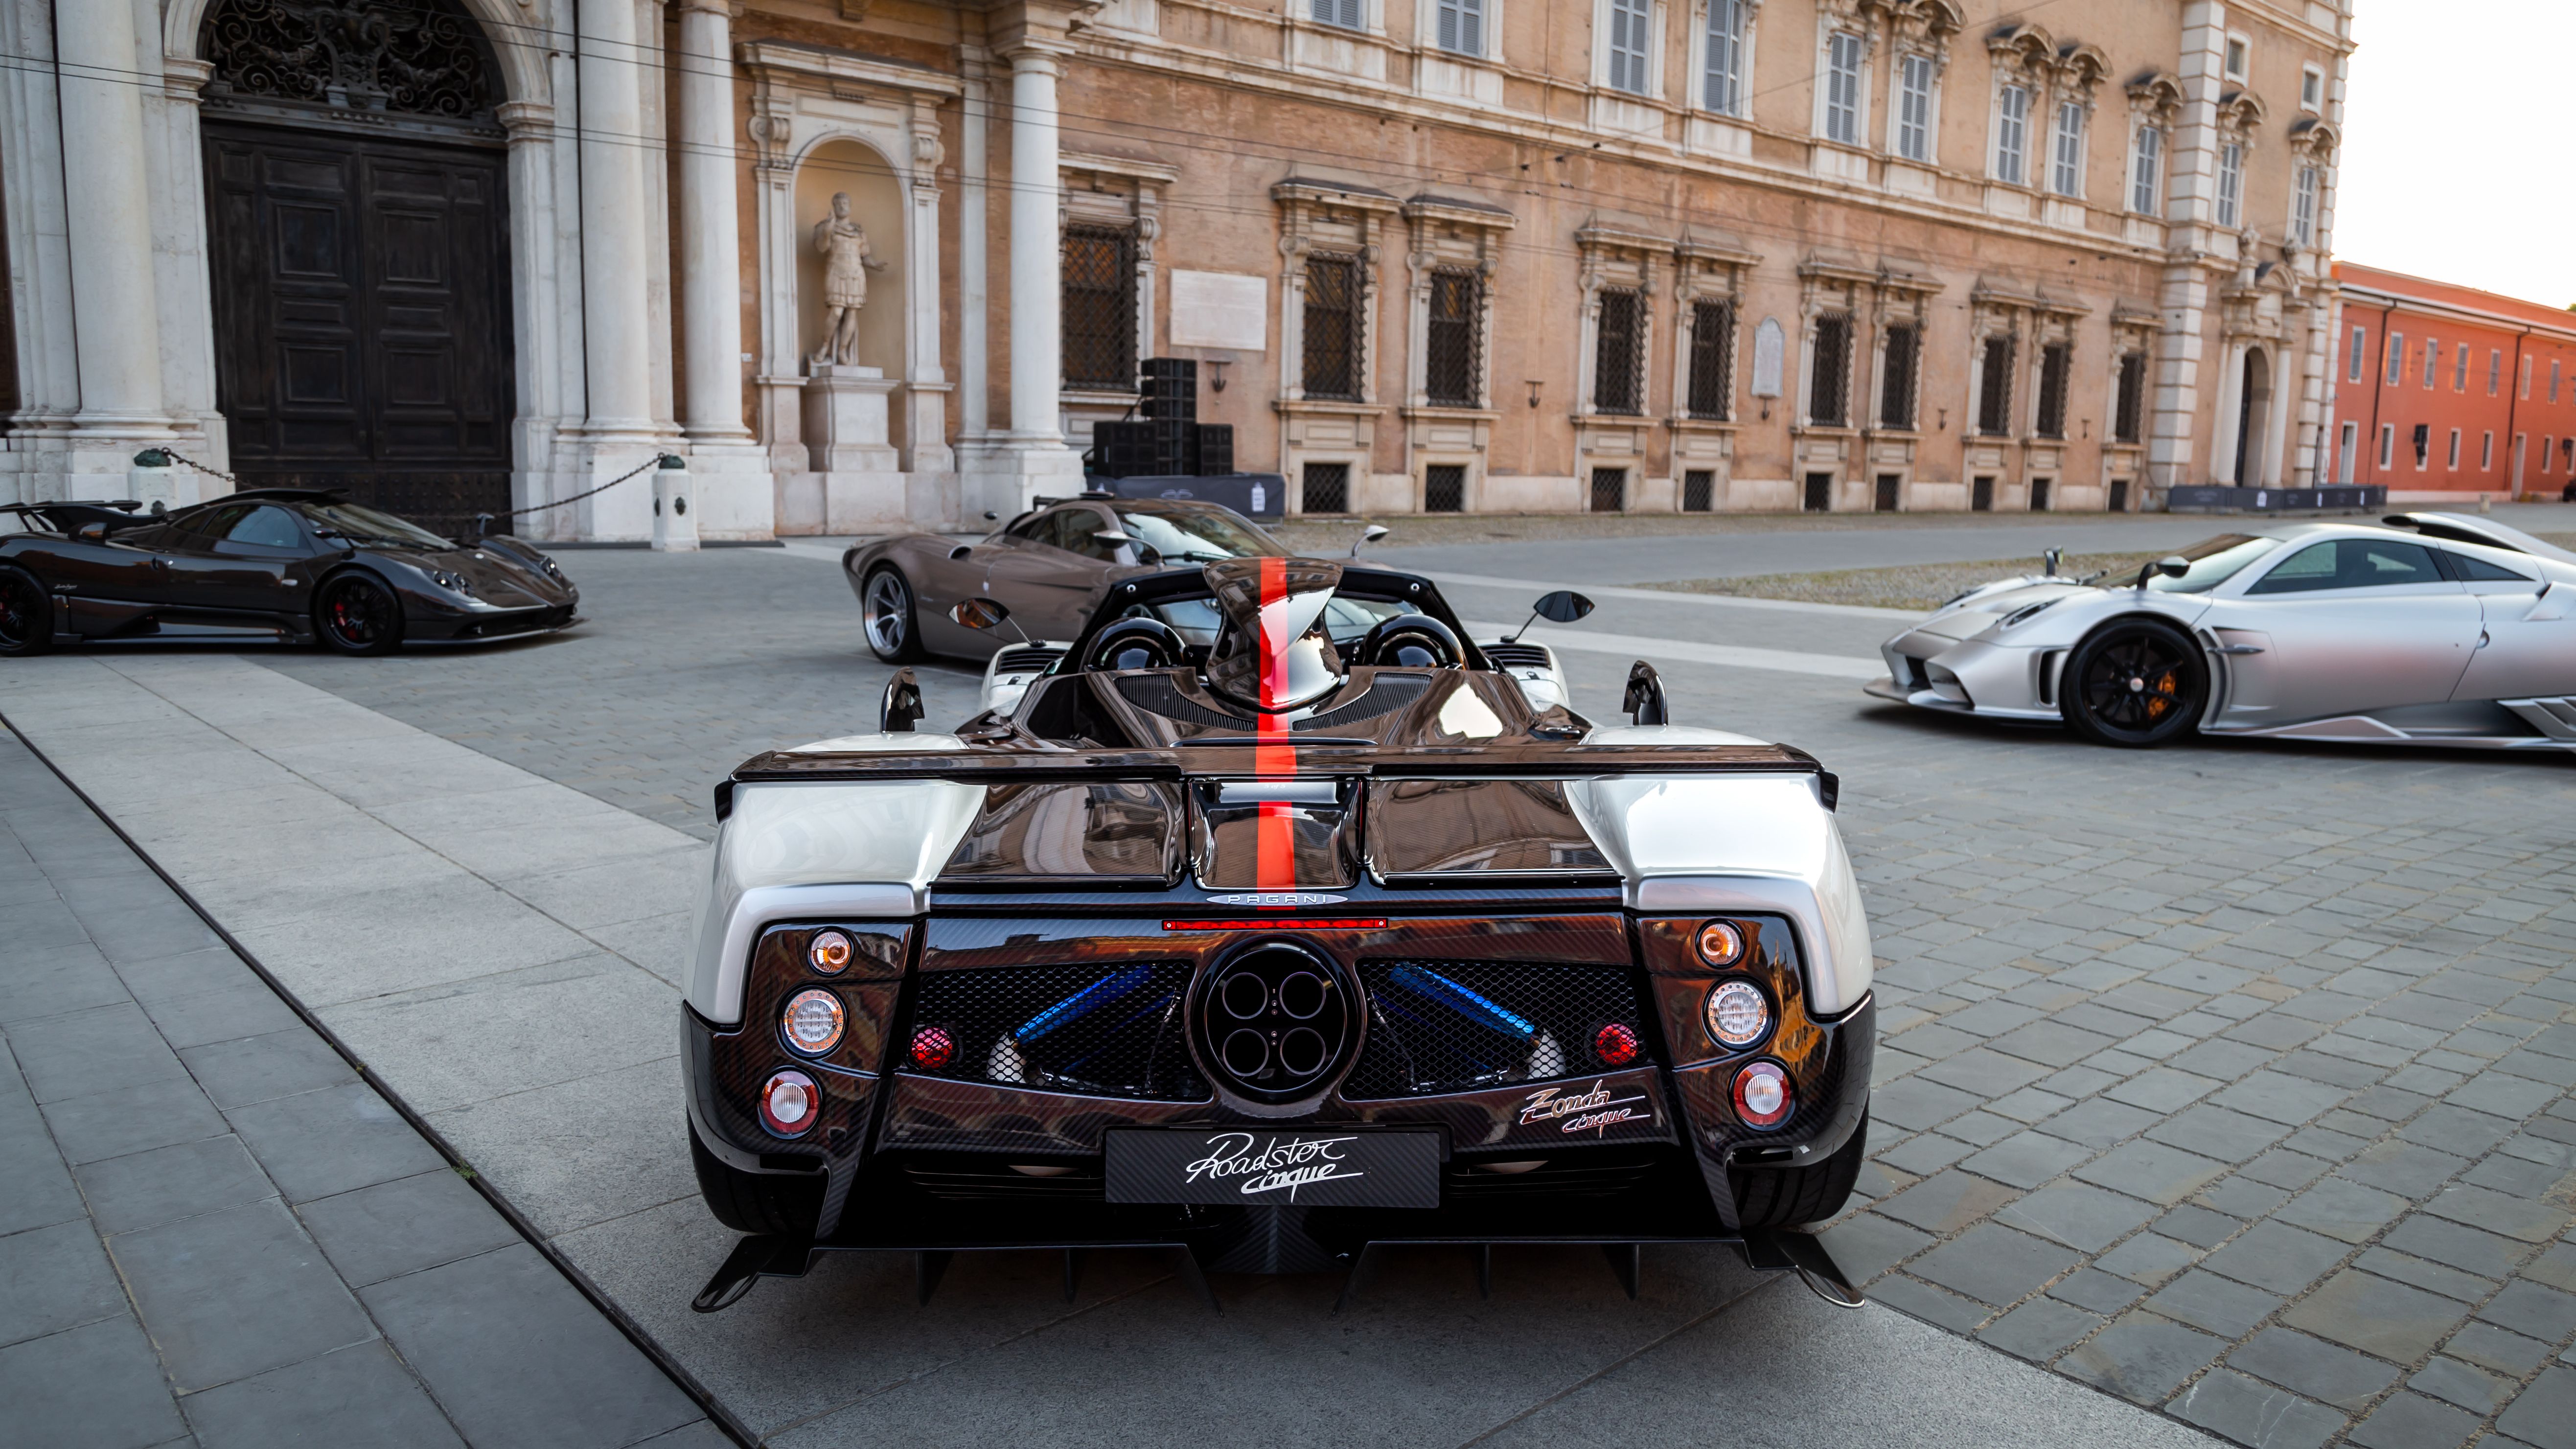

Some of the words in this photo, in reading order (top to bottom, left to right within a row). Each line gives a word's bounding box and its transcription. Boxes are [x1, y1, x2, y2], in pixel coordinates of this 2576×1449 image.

[1227, 895, 1327, 904] PAGANI
[1520, 1079, 1646, 1125] Zonda
[1562, 1108, 1651, 1139] cinque
[1186, 1132, 1358, 1183] Roadster
[1241, 1163, 1364, 1203] cinque
